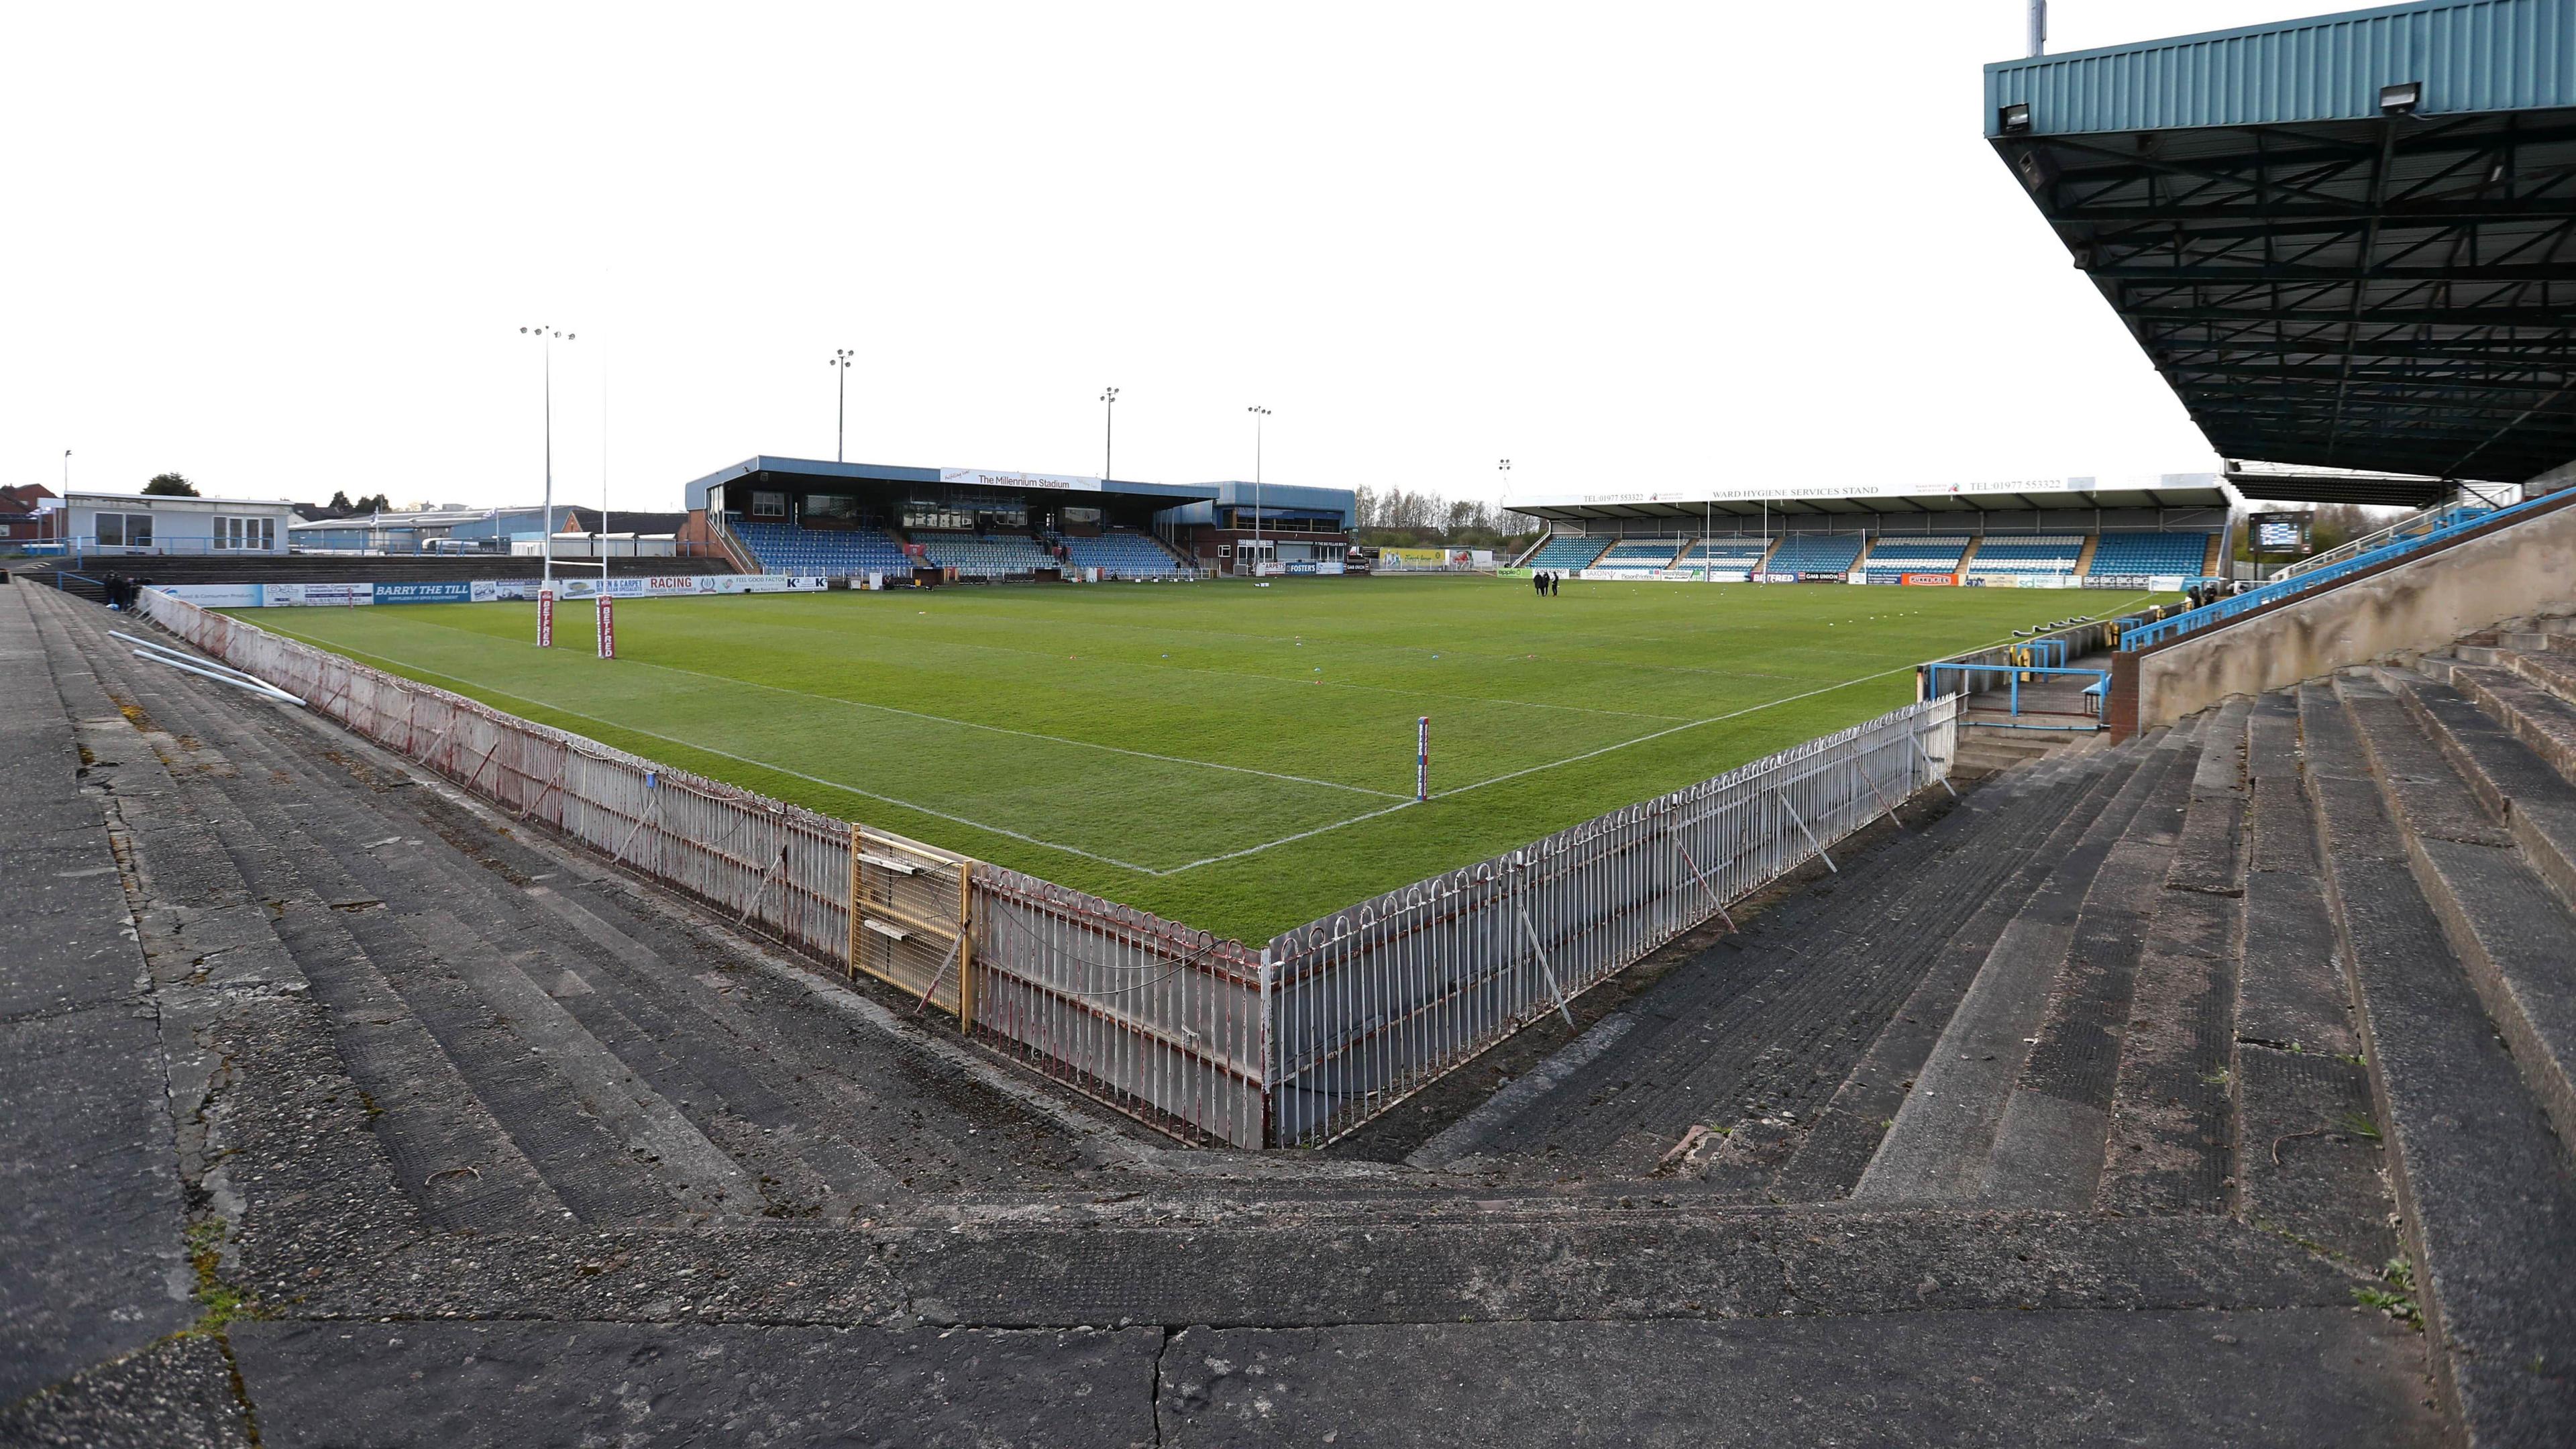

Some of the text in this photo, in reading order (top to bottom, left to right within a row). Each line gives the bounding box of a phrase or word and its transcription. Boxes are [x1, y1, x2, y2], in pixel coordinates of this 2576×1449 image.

[979, 475, 1070, 488] The Millennium Stadium
[2025, 480, 2061, 488] 553322
[1791, 488, 1839, 496] SERVICES
[1842, 486, 1879, 494] STAND
[651, 578, 692, 588] RACING
[1753, 574, 1794, 582] BETFRED
[376, 586, 417, 595] BARRY
[419, 586, 443, 594] THE
[445, 585, 468, 594] TILL
[543, 600, 551, 647] BETFRED
[603, 606, 612, 657] BETFRED
